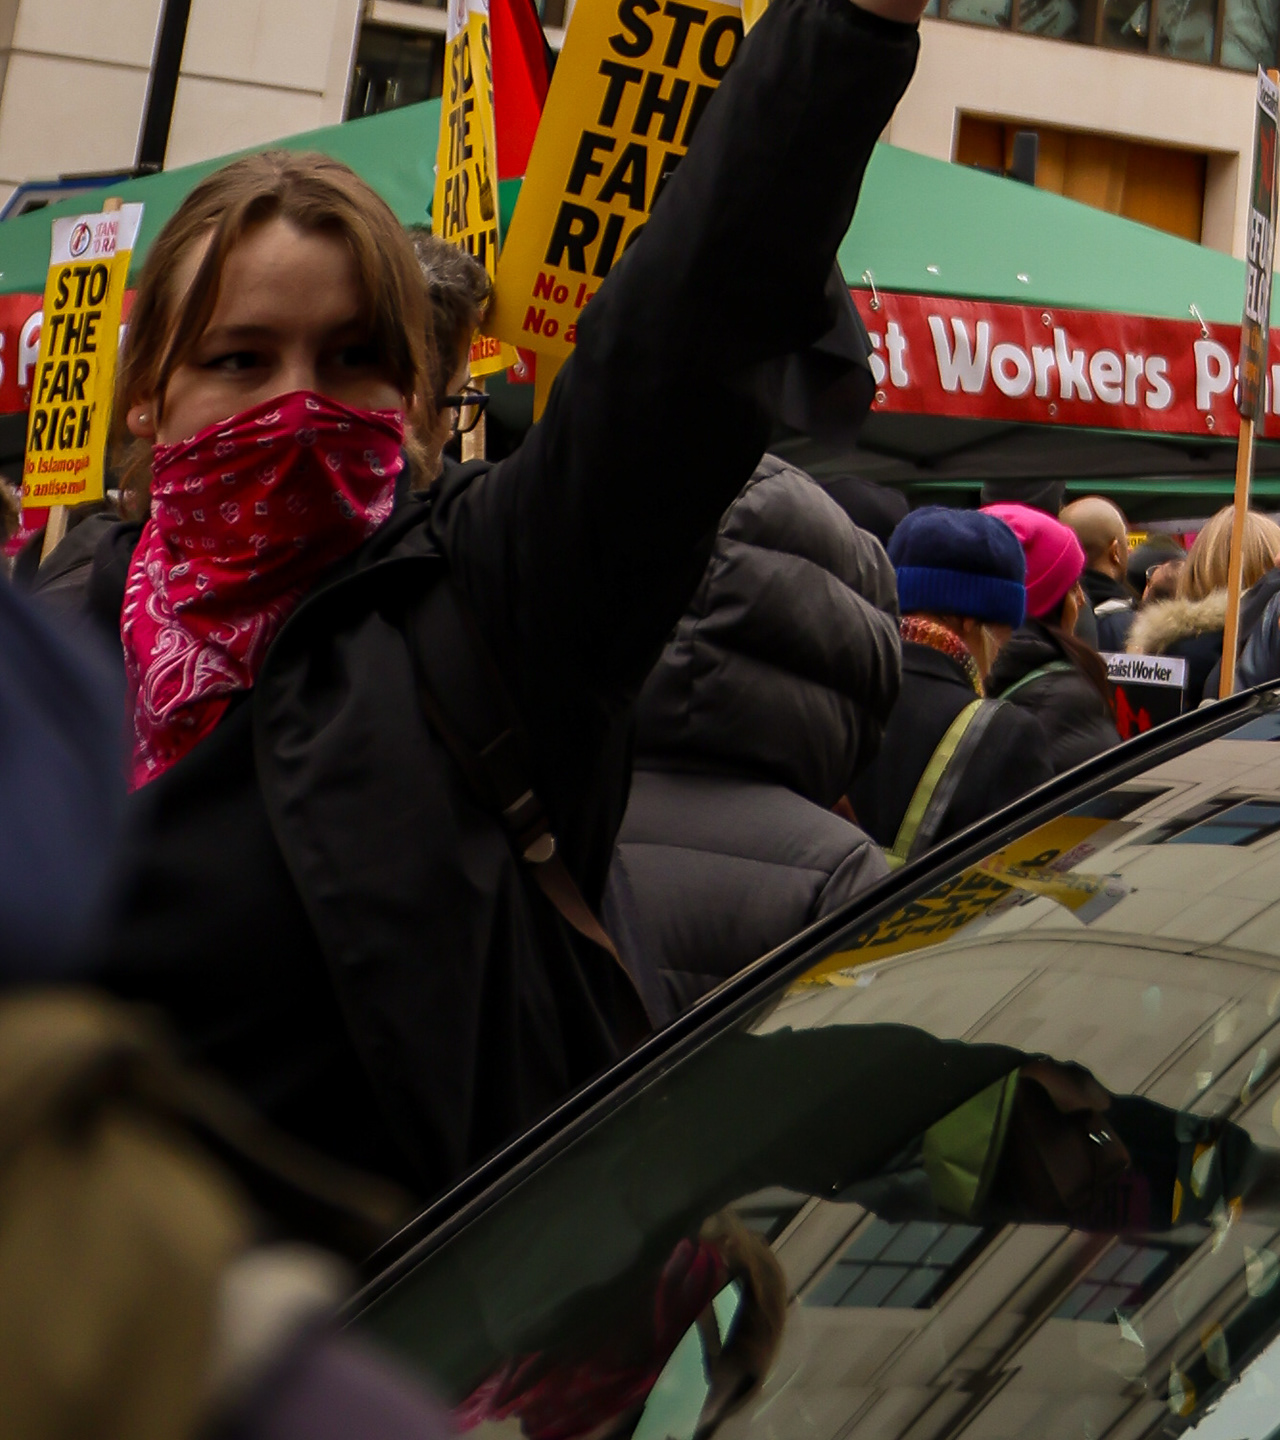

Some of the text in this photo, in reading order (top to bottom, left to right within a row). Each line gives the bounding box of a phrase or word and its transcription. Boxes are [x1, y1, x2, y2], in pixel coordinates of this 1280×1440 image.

[53, 262, 109, 310] STO
[533, 272, 569, 305] No
[47, 310, 102, 357] THE
[522, 306, 559, 337] No
[37, 357, 90, 405] FAR
[928, 314, 1173, 411] Workers
[28, 402, 95, 452] RIGH
[1132, 660, 1172, 681] Worker
